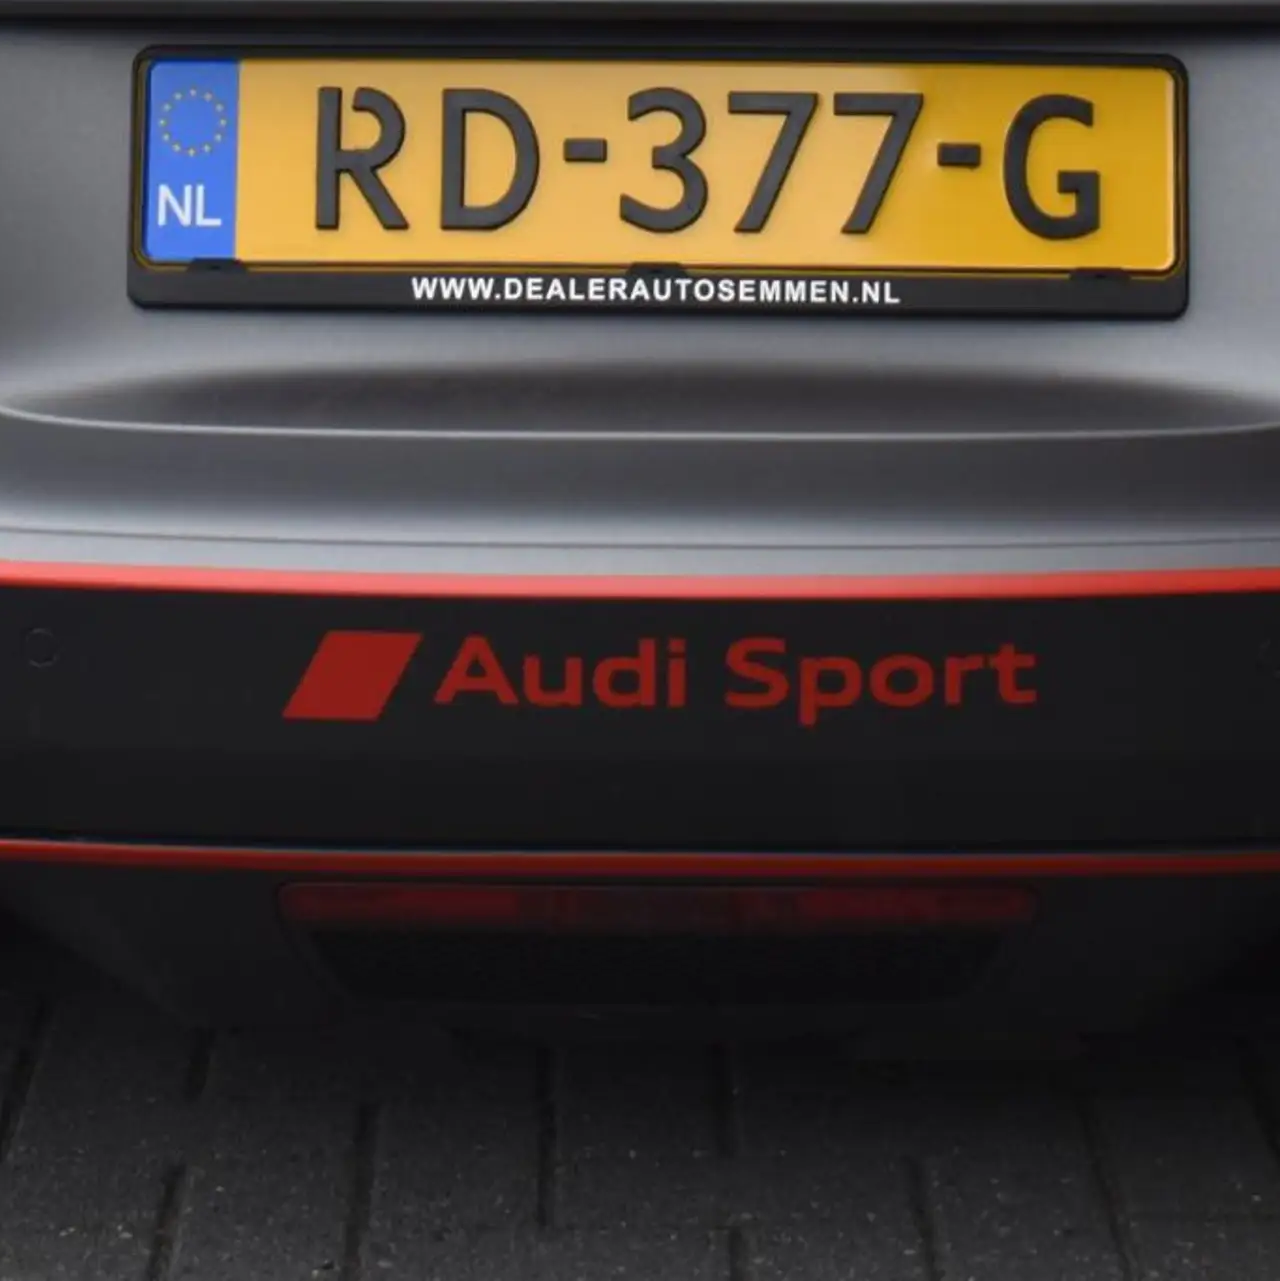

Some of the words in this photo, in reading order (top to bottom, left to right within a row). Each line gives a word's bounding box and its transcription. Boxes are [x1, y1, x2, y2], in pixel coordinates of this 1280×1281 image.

[314, 86, 1102, 242] RD-377-G
[157, 184, 222, 227] NL
[410, 276, 901, 305] WWW.DEALERAUTOSEMMEN.NL
[434, 633, 689, 709] Audi
[725, 637, 1039, 728] Sport
